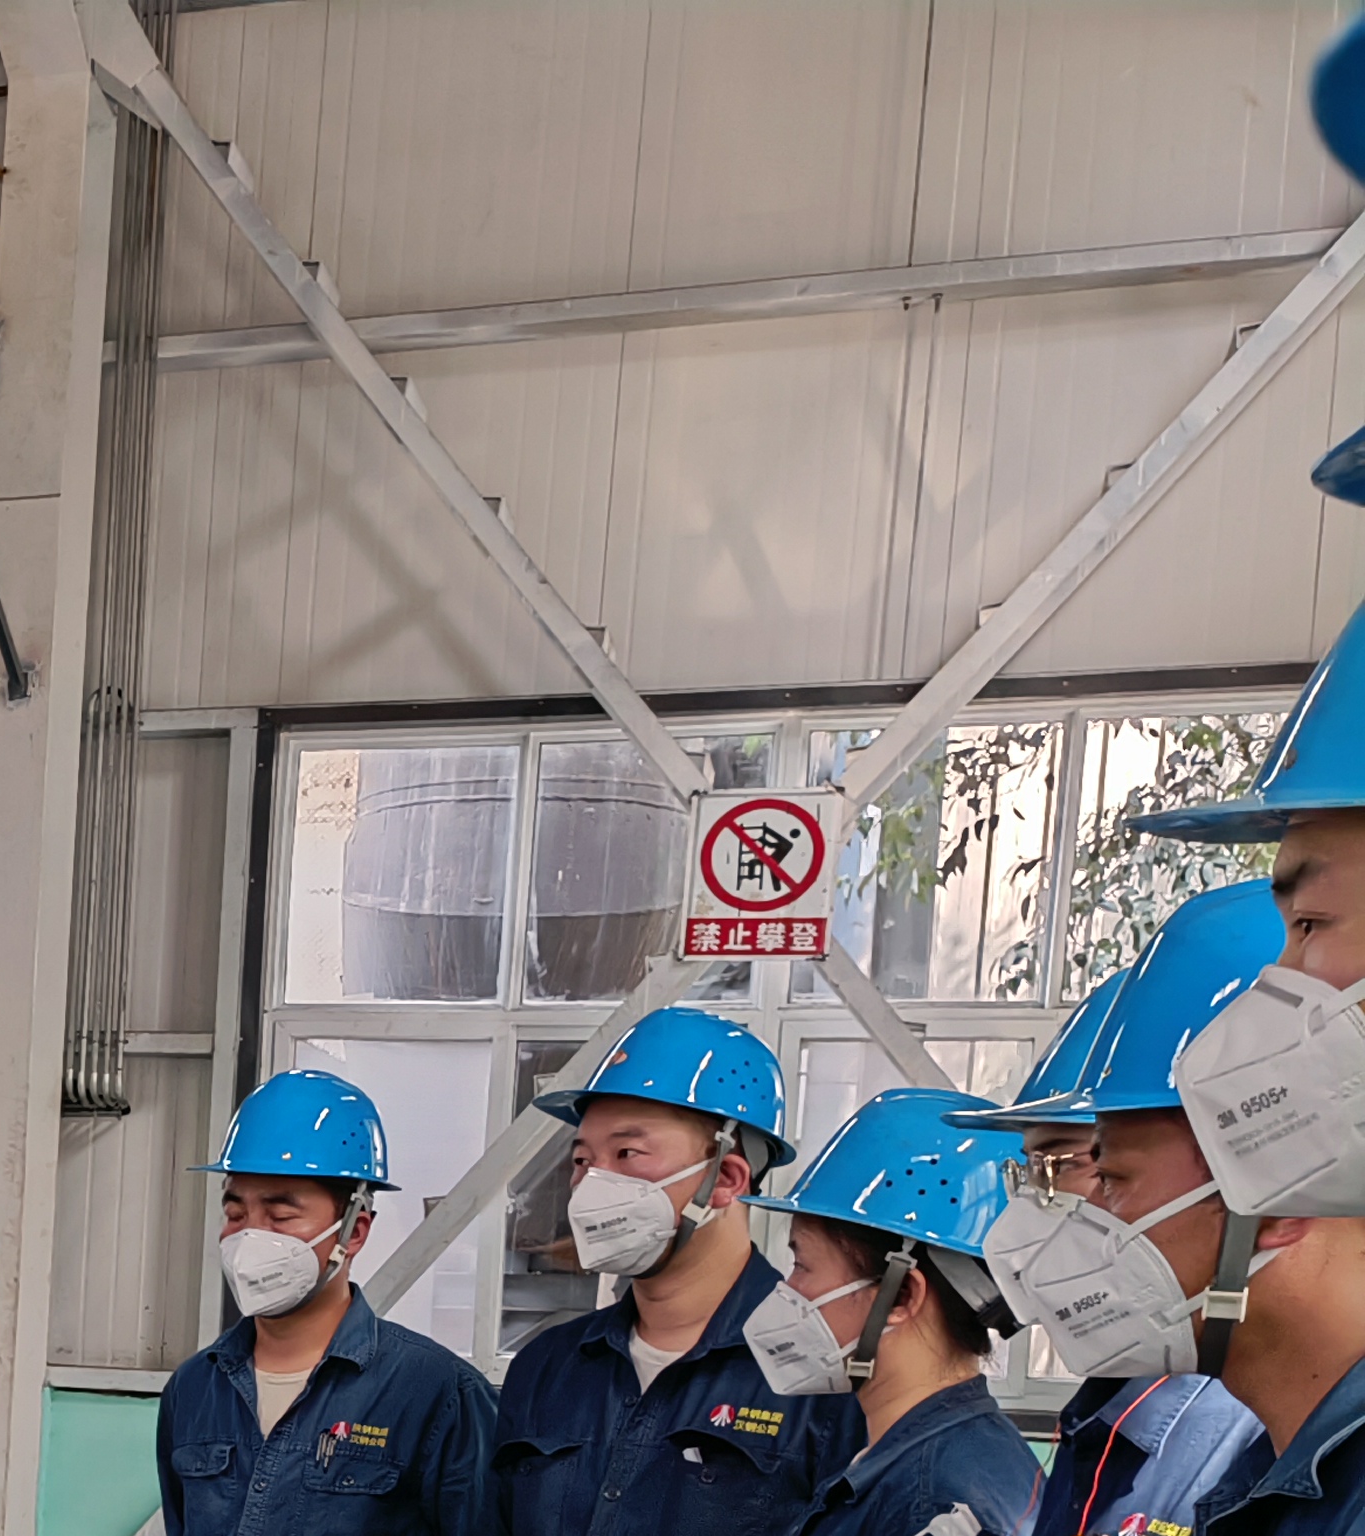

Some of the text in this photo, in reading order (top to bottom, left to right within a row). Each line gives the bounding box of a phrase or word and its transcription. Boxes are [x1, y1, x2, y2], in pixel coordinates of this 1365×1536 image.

[690, 921, 820, 953] 禁止攀登
[1216, 1086, 1288, 1129] 3M 9505+
